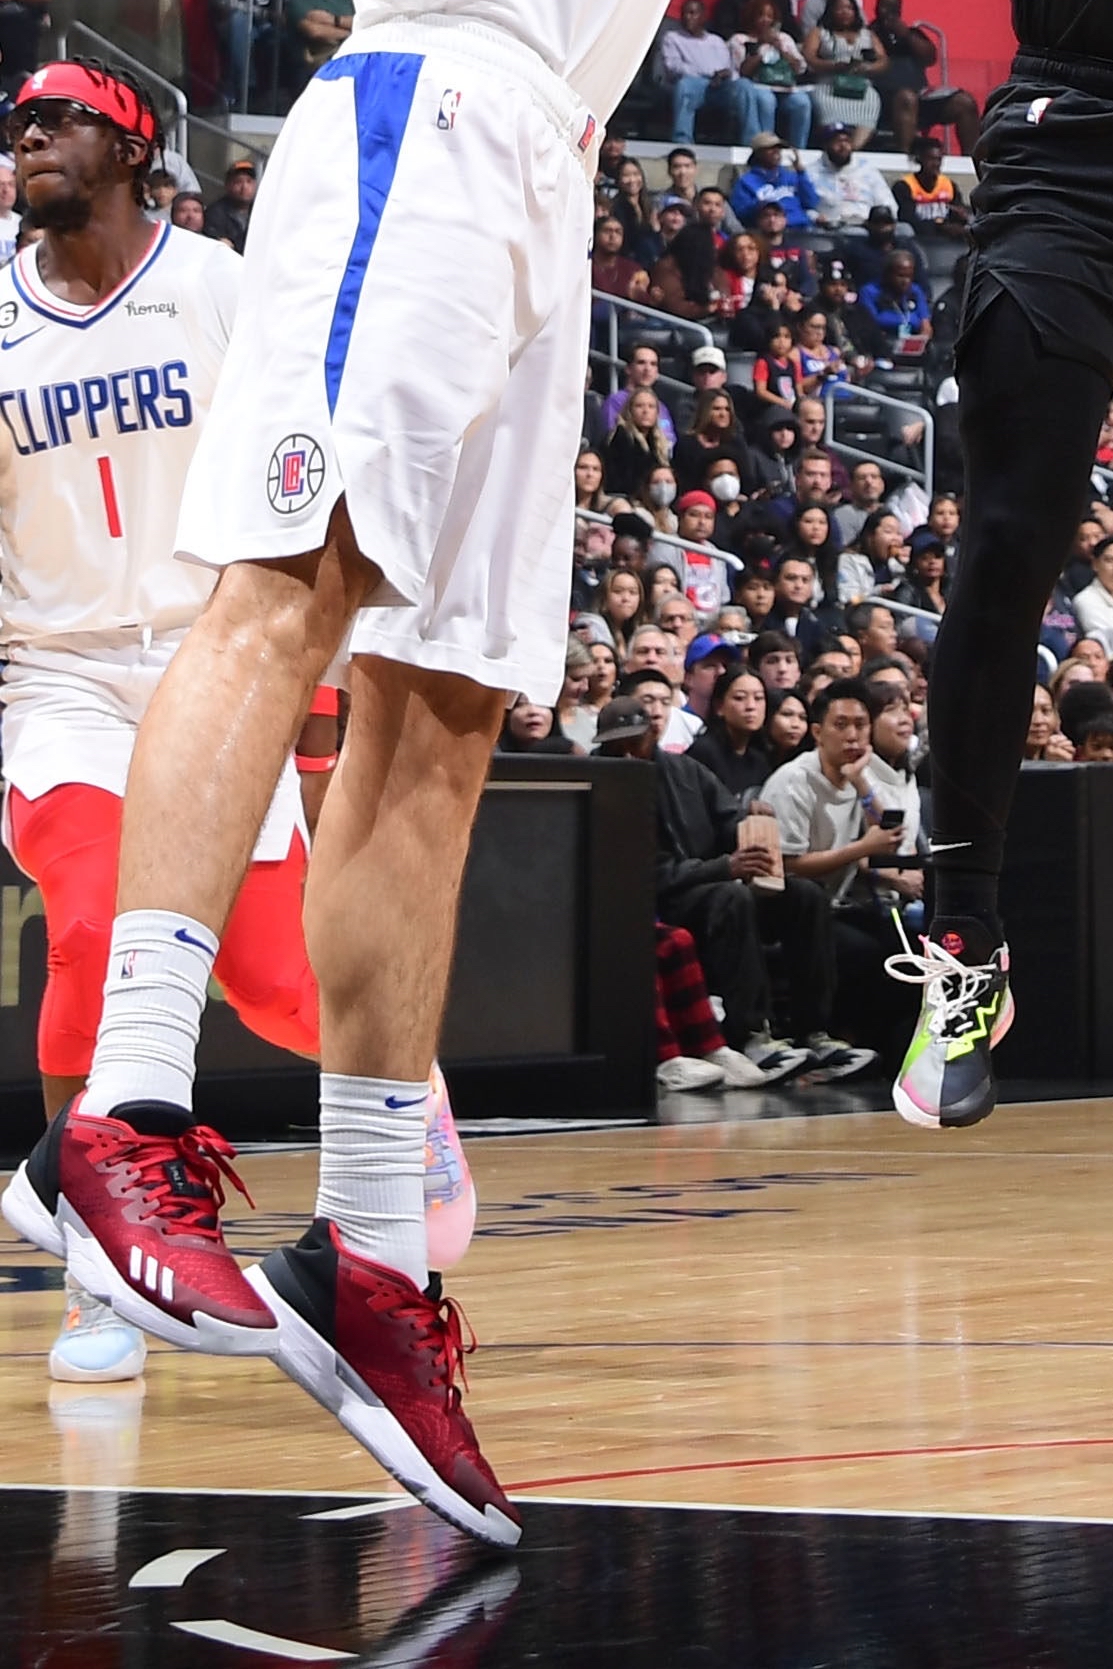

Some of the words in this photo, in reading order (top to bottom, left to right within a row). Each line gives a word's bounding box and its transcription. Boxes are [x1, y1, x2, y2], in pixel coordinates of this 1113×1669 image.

[124, 301, 179, 318] honey
[0, 359, 193, 456] CLIPPERS
[97, 456, 123, 538] 1
